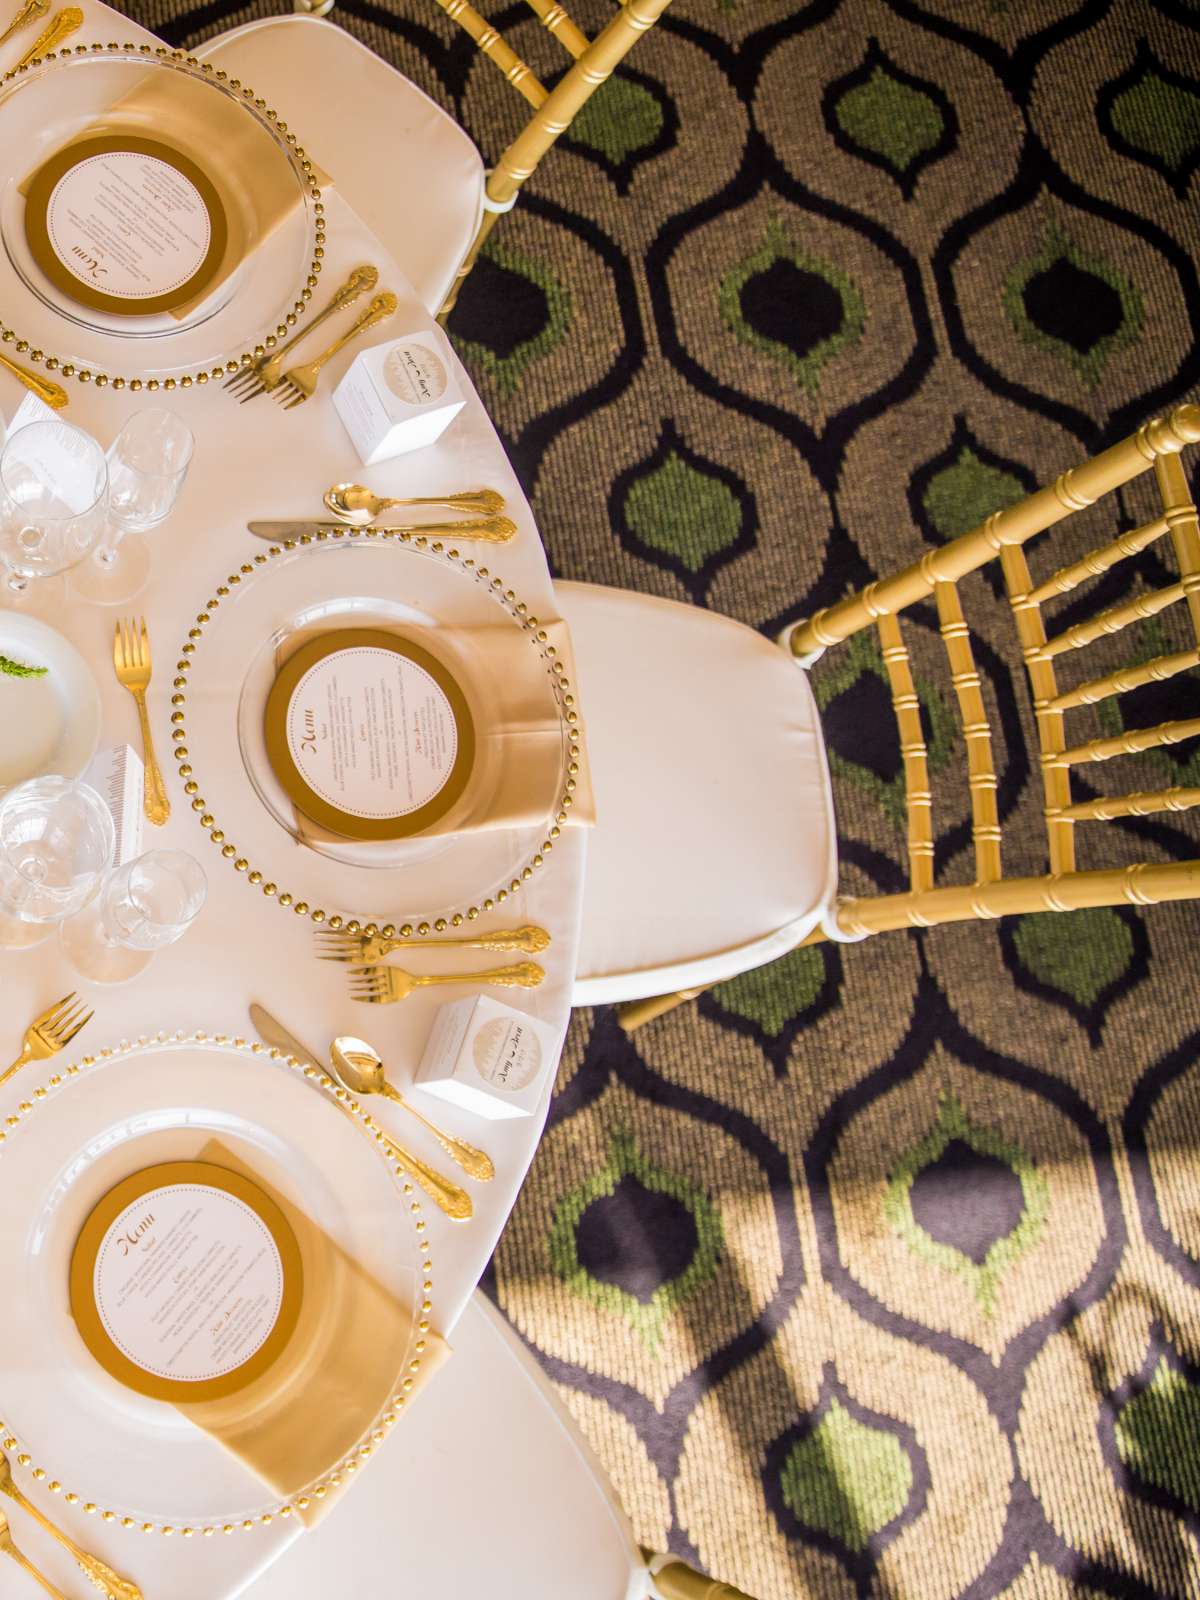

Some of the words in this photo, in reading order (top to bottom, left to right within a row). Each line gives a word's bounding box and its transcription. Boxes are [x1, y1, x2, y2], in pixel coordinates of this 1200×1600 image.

[72, 246, 108, 278] Menu
[301, 709, 317, 755] Menu
[116, 1213, 156, 1257] Menu
